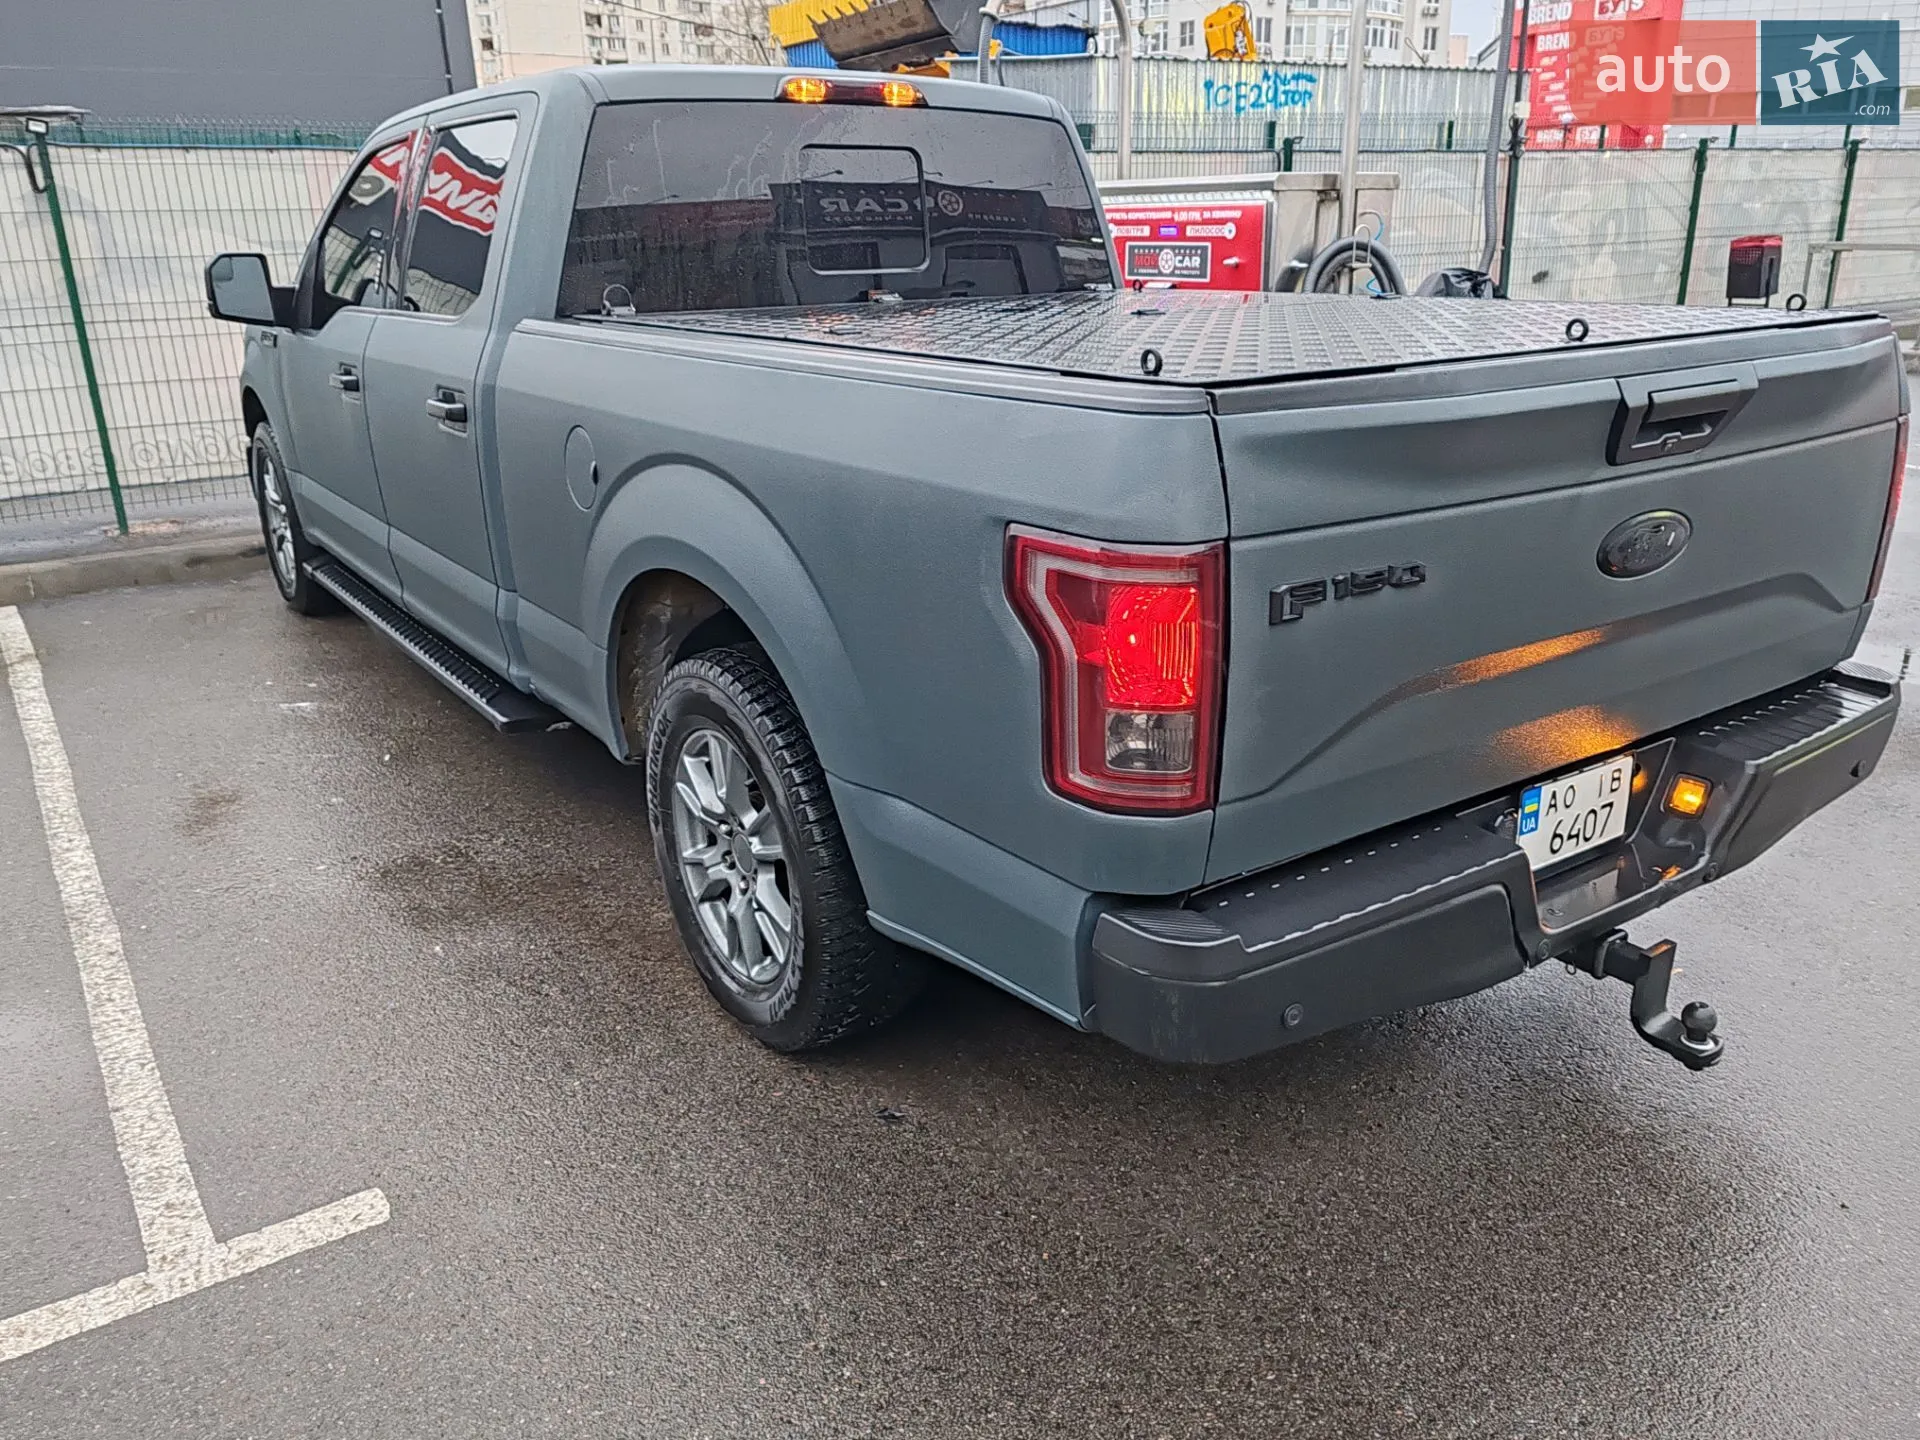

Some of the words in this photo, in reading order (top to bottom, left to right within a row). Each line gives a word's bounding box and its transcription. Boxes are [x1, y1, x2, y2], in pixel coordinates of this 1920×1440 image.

[1116, 227, 1145, 235] ПОВІТРЯ
[1189, 226, 1225, 235] ПИЛОСОС
[1175, 255, 1201, 268] CAR
[1545, 784, 1576, 817] AO
[1598, 767, 1623, 799] IB
[1521, 816, 1536, 833] UA
[1549, 801, 1614, 855] 6407
